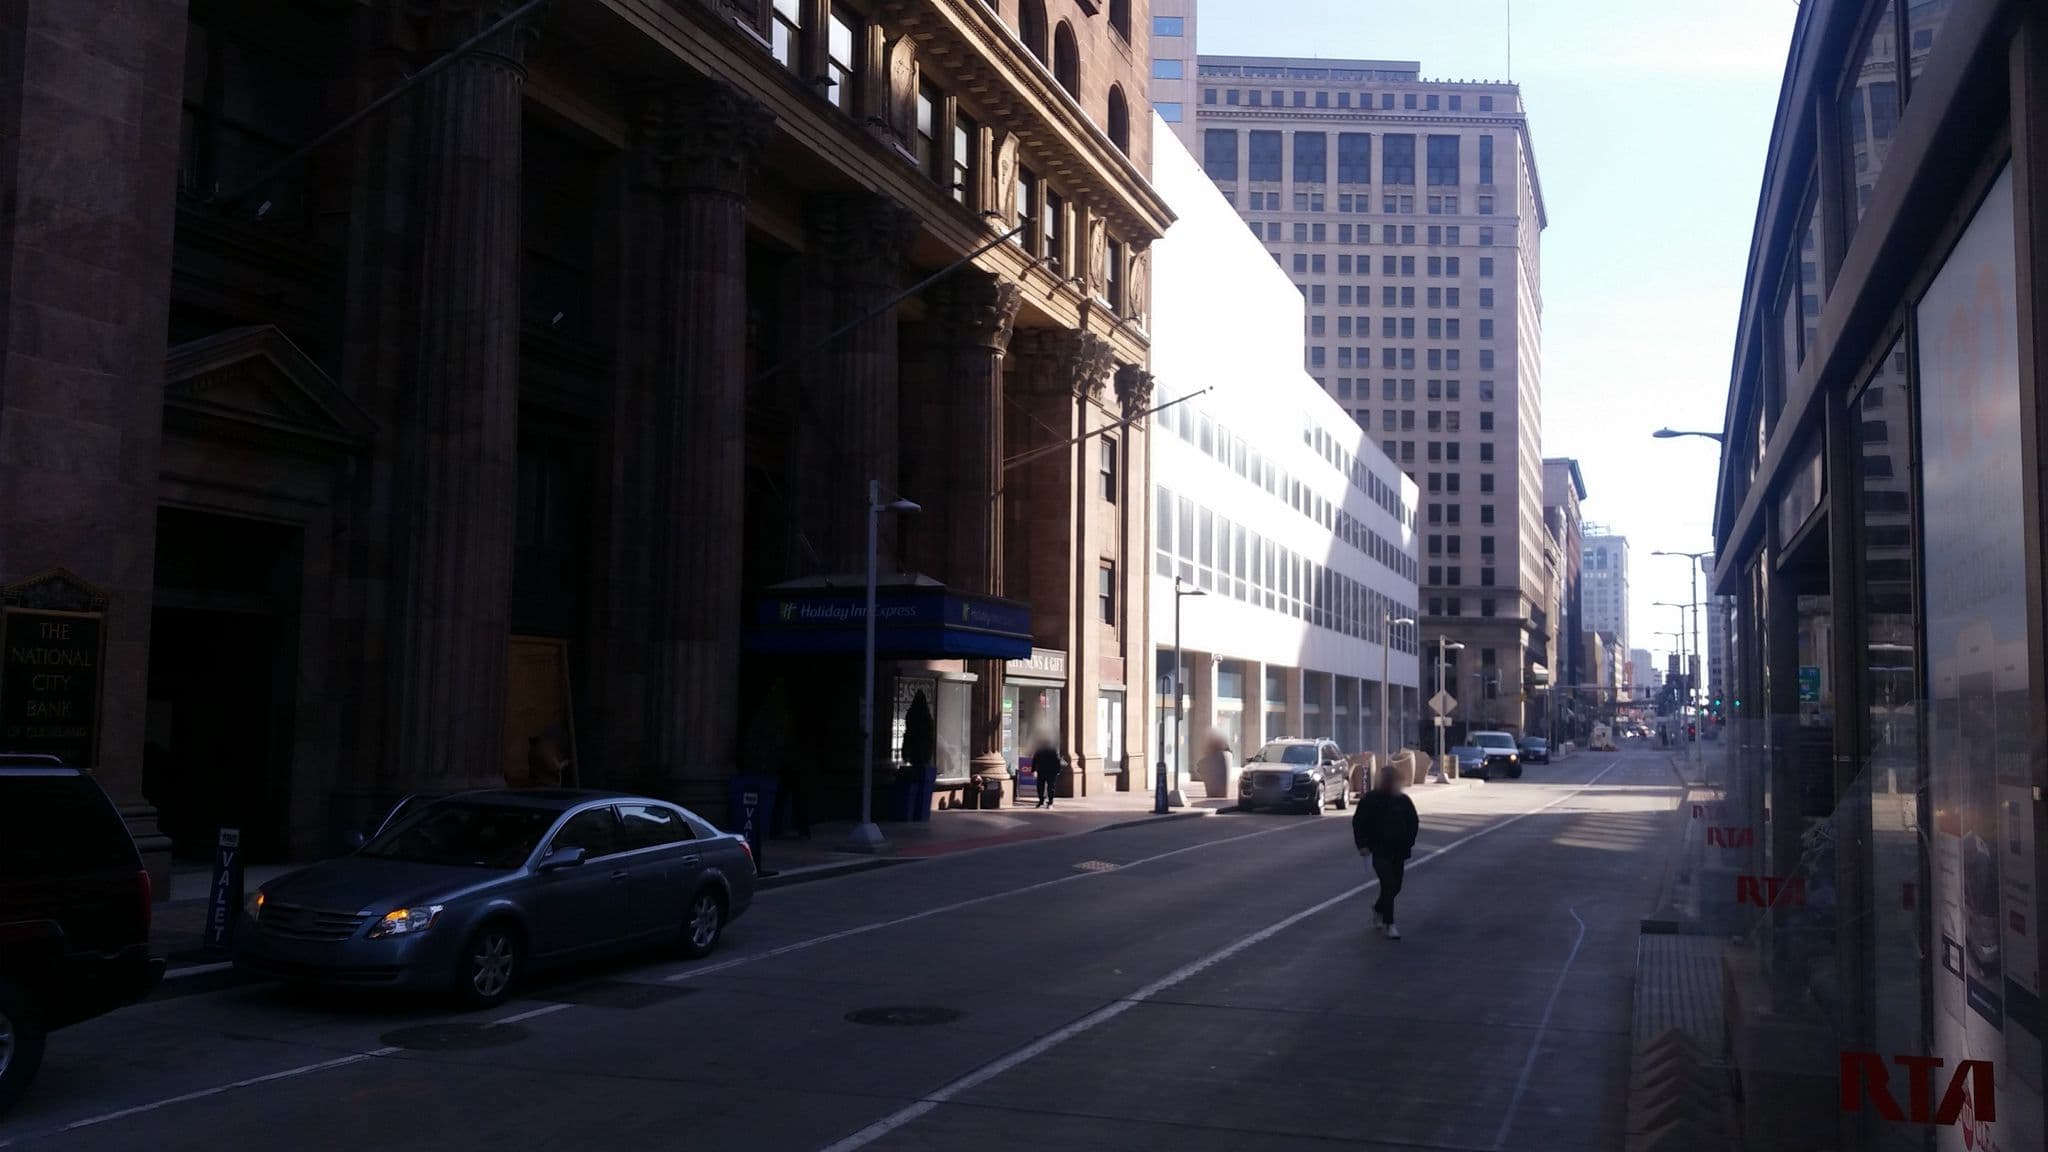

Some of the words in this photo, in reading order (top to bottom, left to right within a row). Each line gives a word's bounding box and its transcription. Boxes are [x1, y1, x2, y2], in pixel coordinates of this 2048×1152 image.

[800, 604, 848, 620] Holiday
[41, 623, 72, 640] THE
[10, 648, 91, 666] NATIONAL
[33, 674, 72, 691] CITY
[26, 700, 72, 718] BANK
[743, 808, 755, 841] VAL
[1707, 826, 1754, 849] RTA
[215, 851, 234, 943] VALET
[1737, 875, 1806, 908] RTA
[1840, 1052, 1996, 1126] RTA
